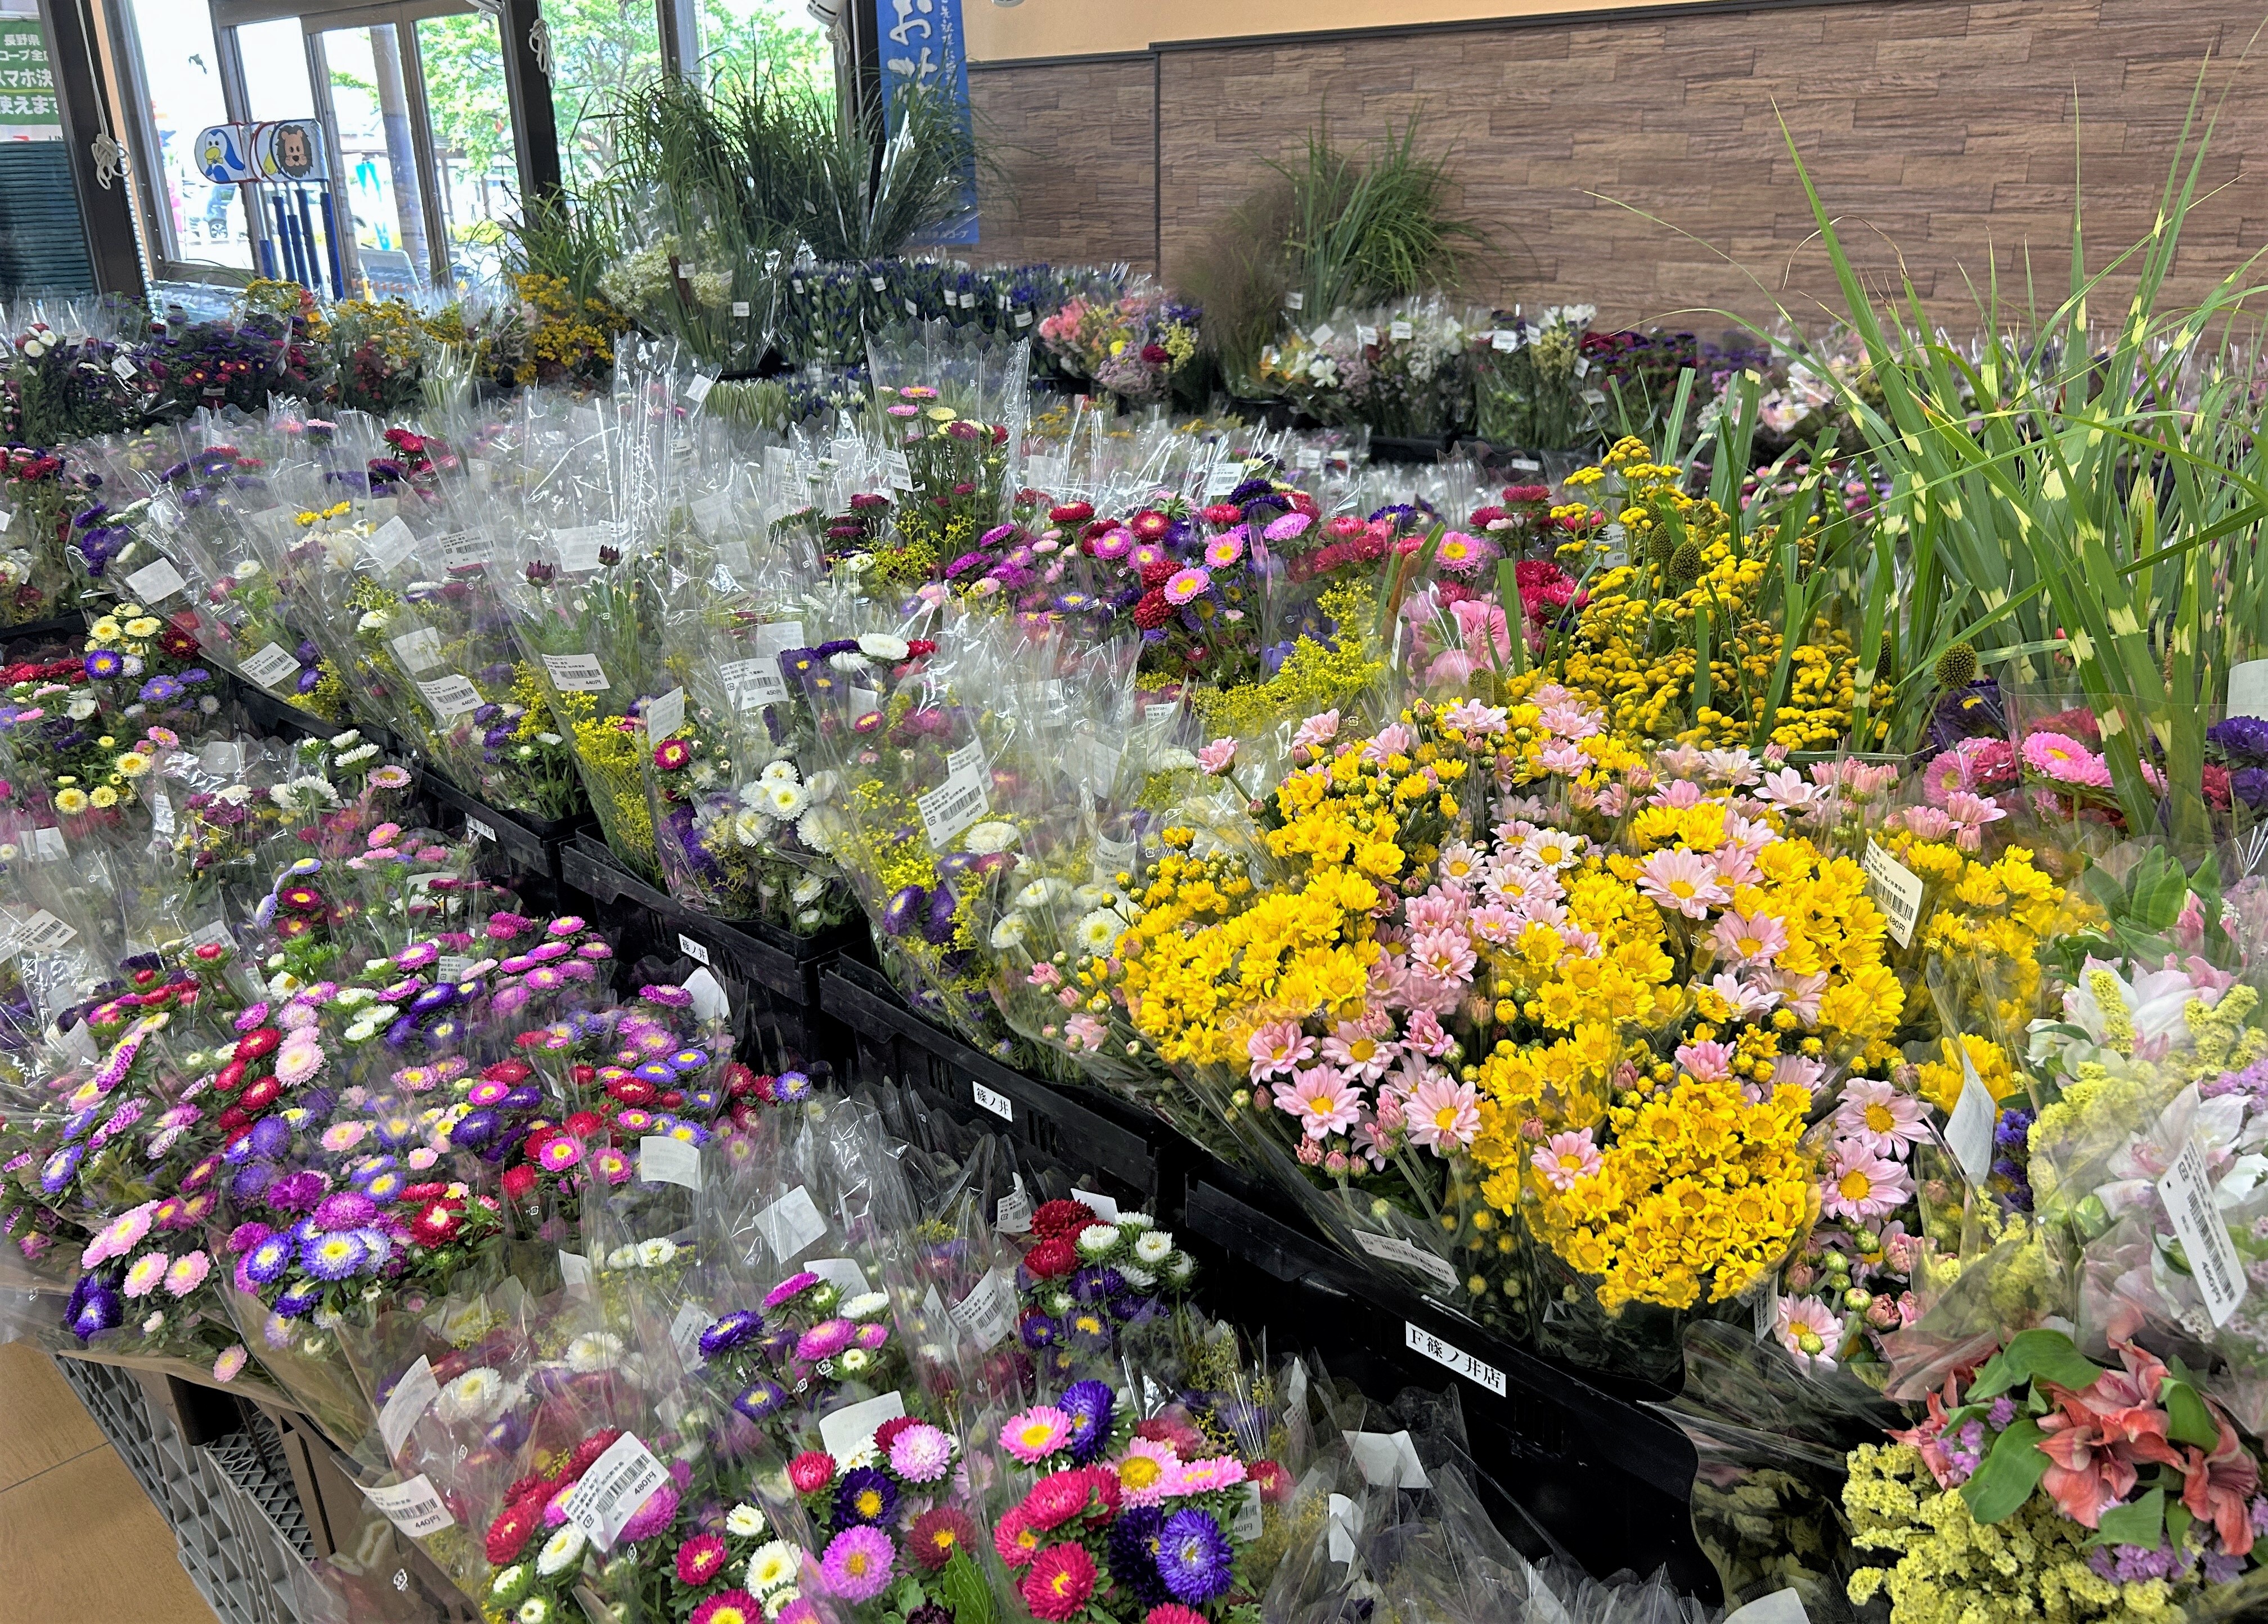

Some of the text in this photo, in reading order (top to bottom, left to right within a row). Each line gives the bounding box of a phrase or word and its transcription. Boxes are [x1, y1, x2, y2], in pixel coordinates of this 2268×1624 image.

[4, 34, 40, 46] 長野県
[461, 698, 477, 706] 440円
[966, 802, 982, 818] 440円
[1888, 916, 1906, 935] 480円
[977, 1088, 1009, 1115] 篠ノ井
[574, 1470, 595, 1499] 花(アスター)
[635, 1470, 657, 1496] 480円
[415, 1514, 440, 1528] 440円
